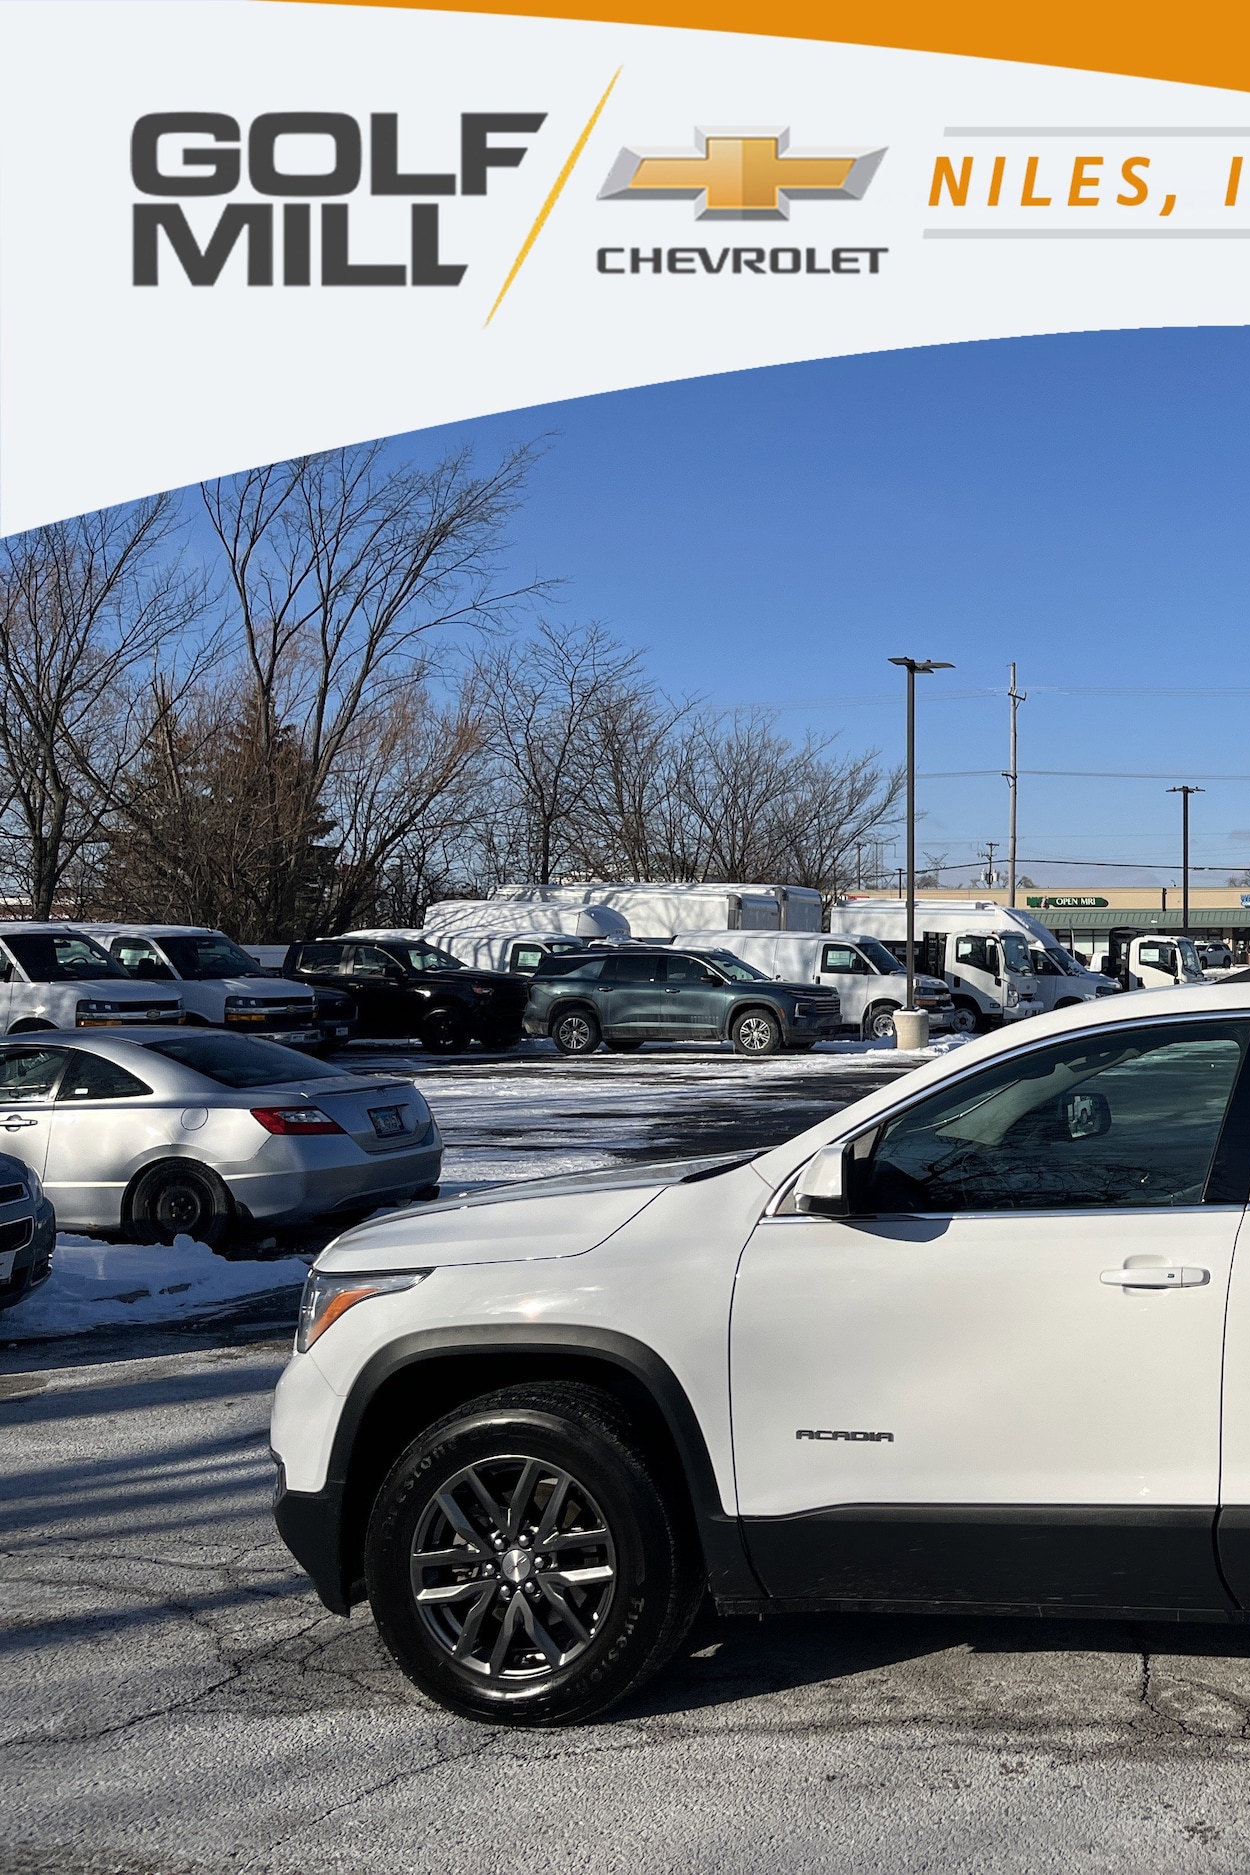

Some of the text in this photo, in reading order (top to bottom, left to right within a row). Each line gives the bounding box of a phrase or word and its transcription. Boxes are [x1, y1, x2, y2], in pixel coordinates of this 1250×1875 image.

[1056, 897, 1096, 905] OPEN MRI
[796, 1430, 894, 1442] ACADIA
